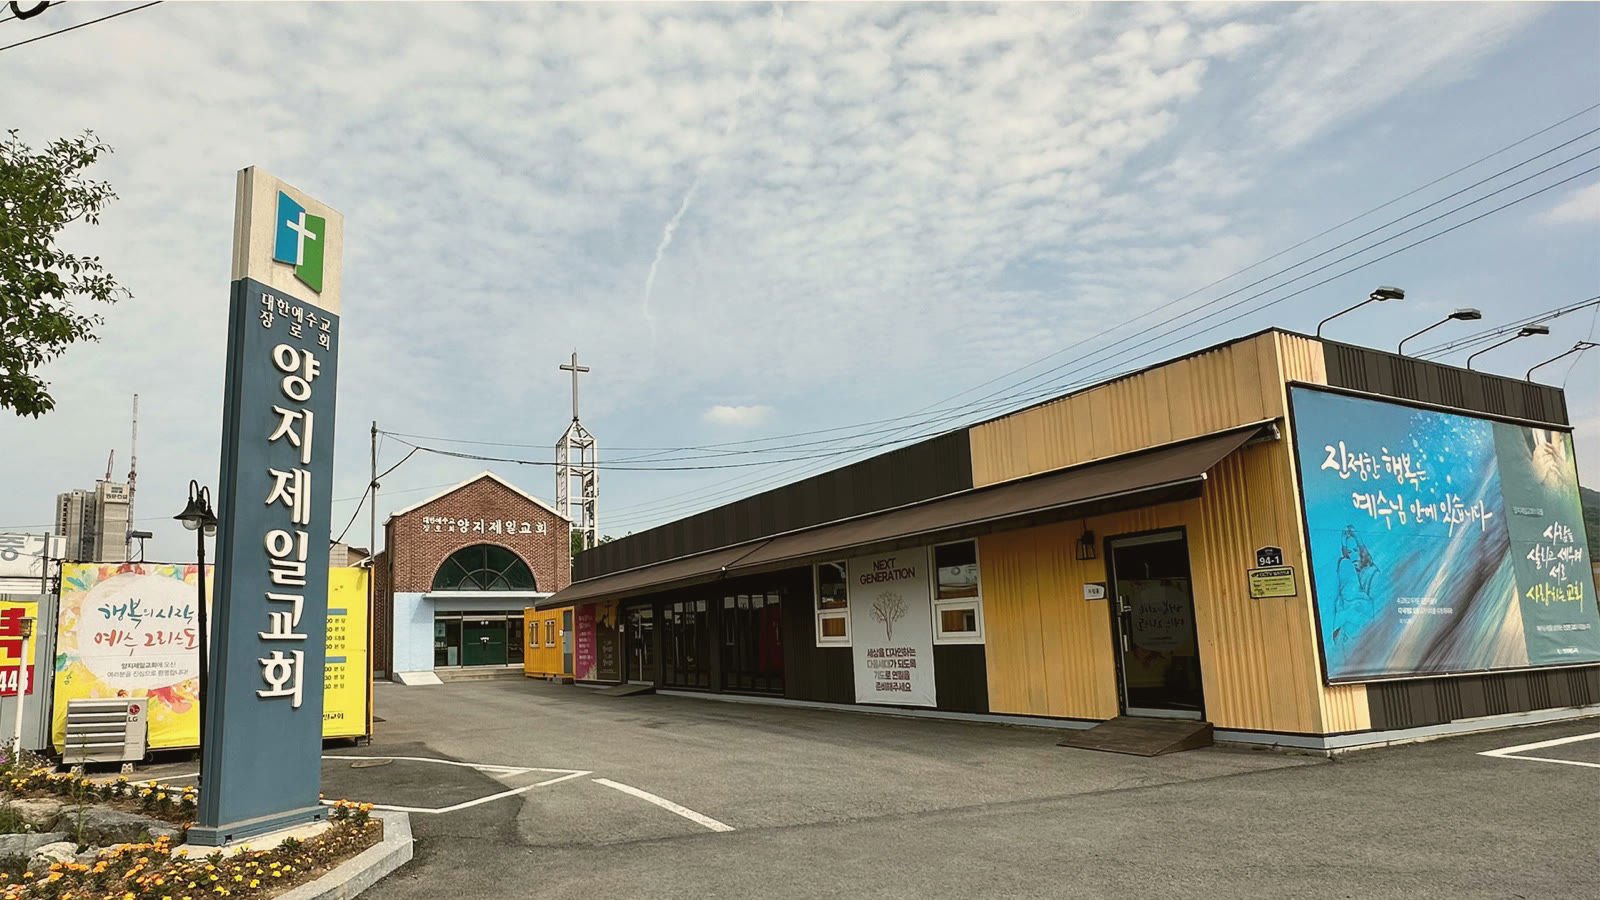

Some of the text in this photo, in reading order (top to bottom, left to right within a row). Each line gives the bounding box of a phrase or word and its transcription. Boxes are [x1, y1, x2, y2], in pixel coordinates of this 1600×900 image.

[261, 293, 331, 333] 대한예수교
[260, 310, 330, 351] 장로회
[1321, 440, 1427, 491] 진정한 행복은
[256, 343, 320, 707] 양지제일교회
[1352, 490, 1493, 538] 예수님 안에 있습니다
[457, 518, 547, 536] 양지제일교회
[873, 557, 896, 571] NEXT
[1259, 556, 1280, 566] 94-1
[860, 567, 916, 585] GENERATION
[94, 628, 198, 656] 예수 그리스도
[867, 647, 916, 658] 세상을 디자인하는
[897, 659, 916, 668] 되도록
